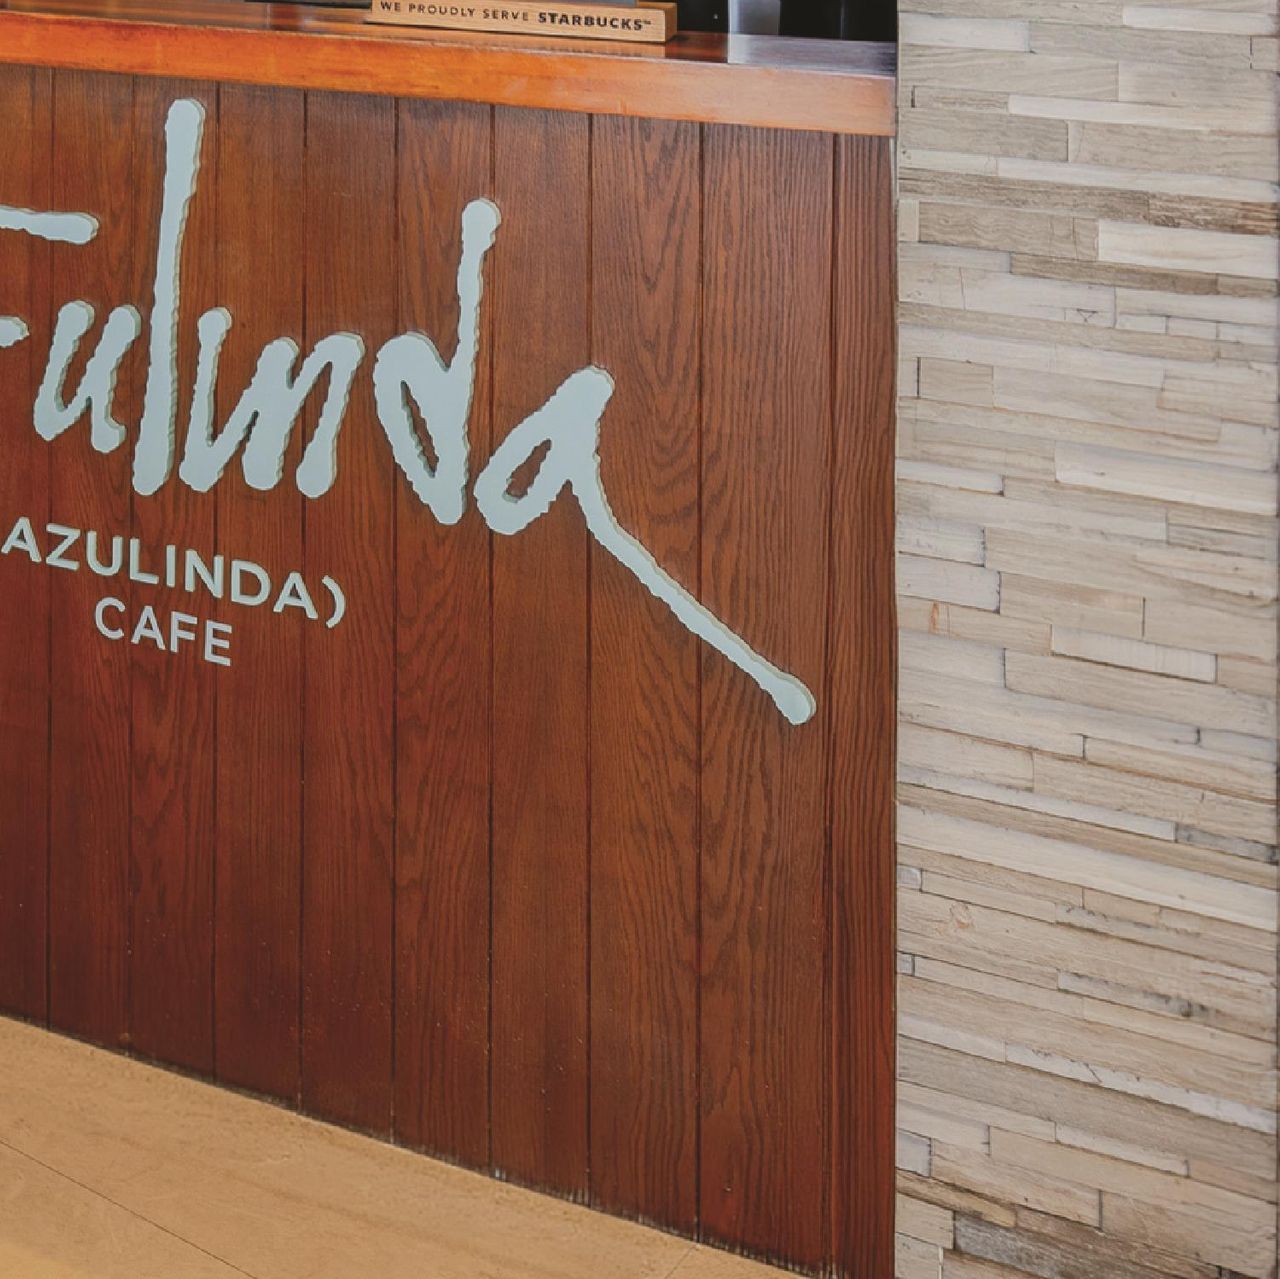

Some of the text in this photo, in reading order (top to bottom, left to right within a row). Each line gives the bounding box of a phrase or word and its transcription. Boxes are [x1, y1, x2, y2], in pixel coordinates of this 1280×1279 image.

[380, 0, 401, 12] WE
[408, 2, 476, 18] PROUDLY
[482, 9, 529, 21] SERVE
[93, 595, 234, 666] CAFE
